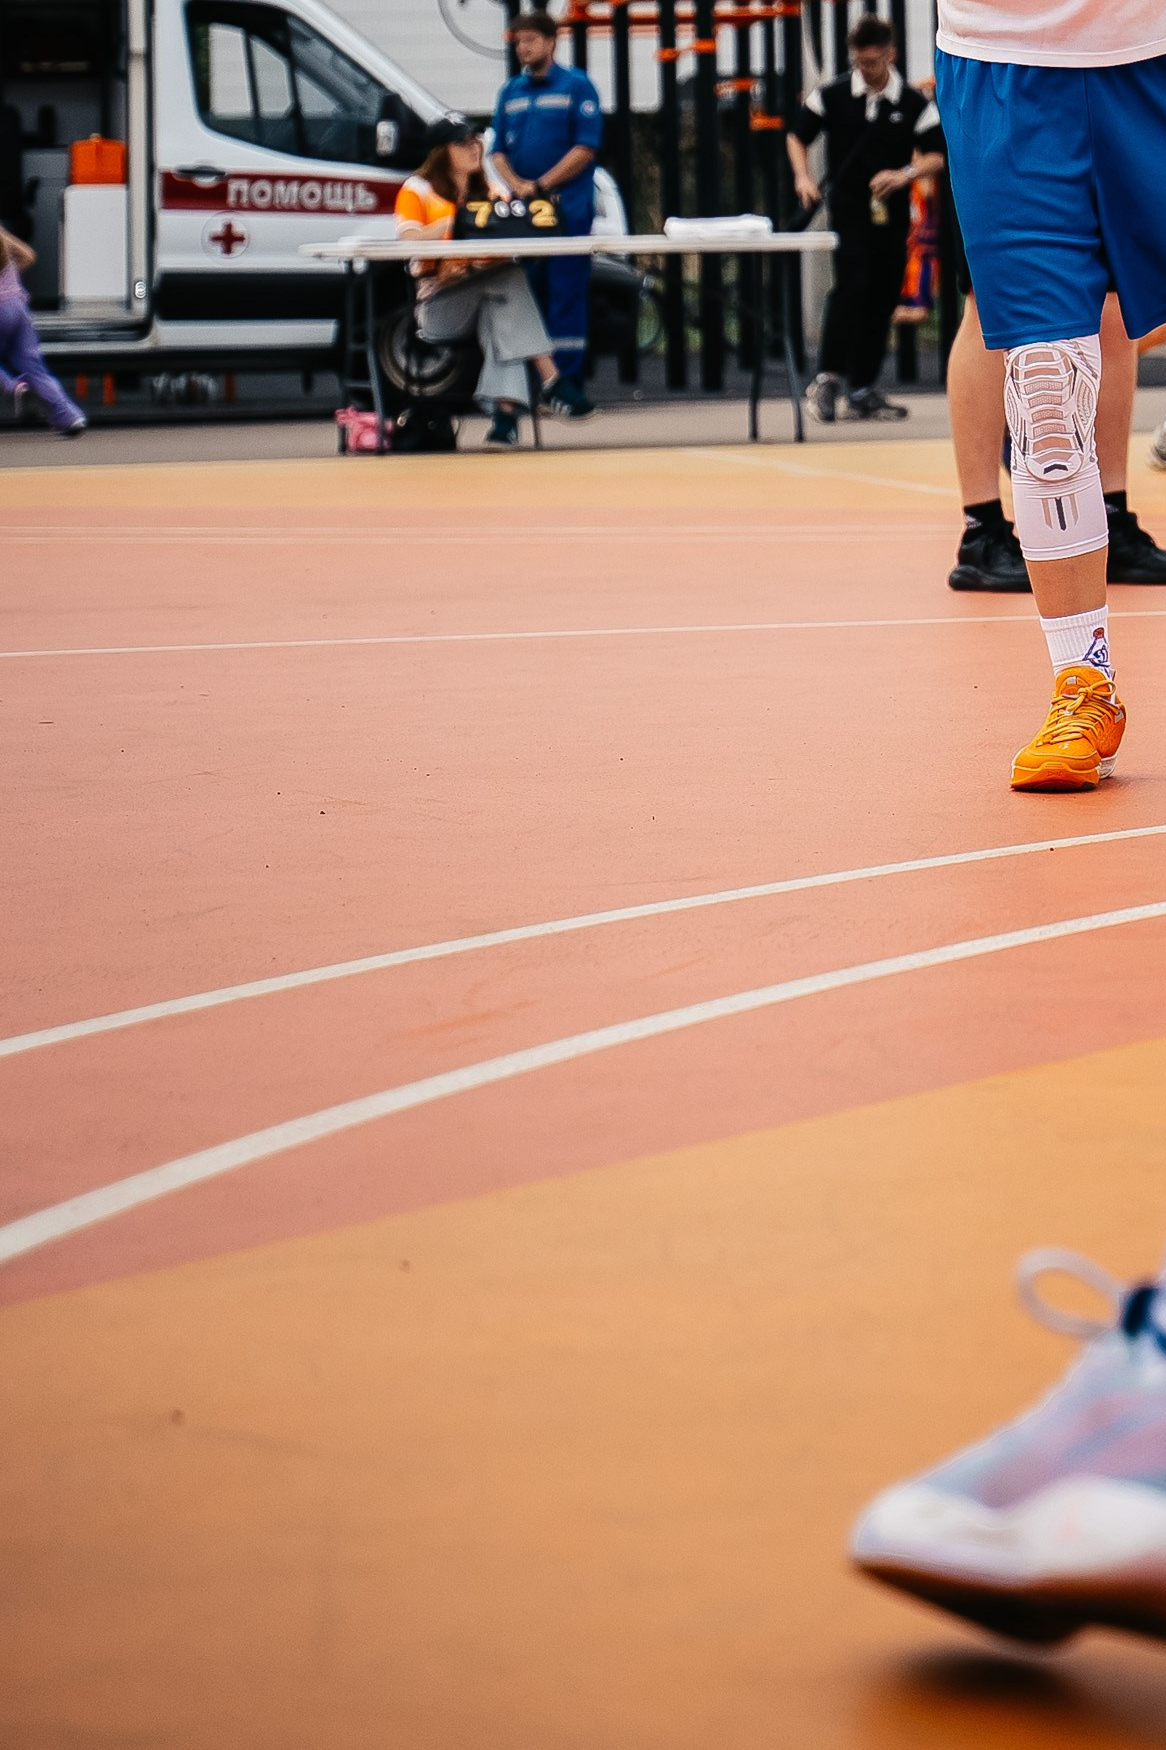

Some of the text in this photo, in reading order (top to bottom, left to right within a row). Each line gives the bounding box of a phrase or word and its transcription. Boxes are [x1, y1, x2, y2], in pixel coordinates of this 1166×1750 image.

[227, 178, 379, 212] ПОМОЩЬ
[466, 201, 492, 228] 7
[529, 199, 558, 227] 2
